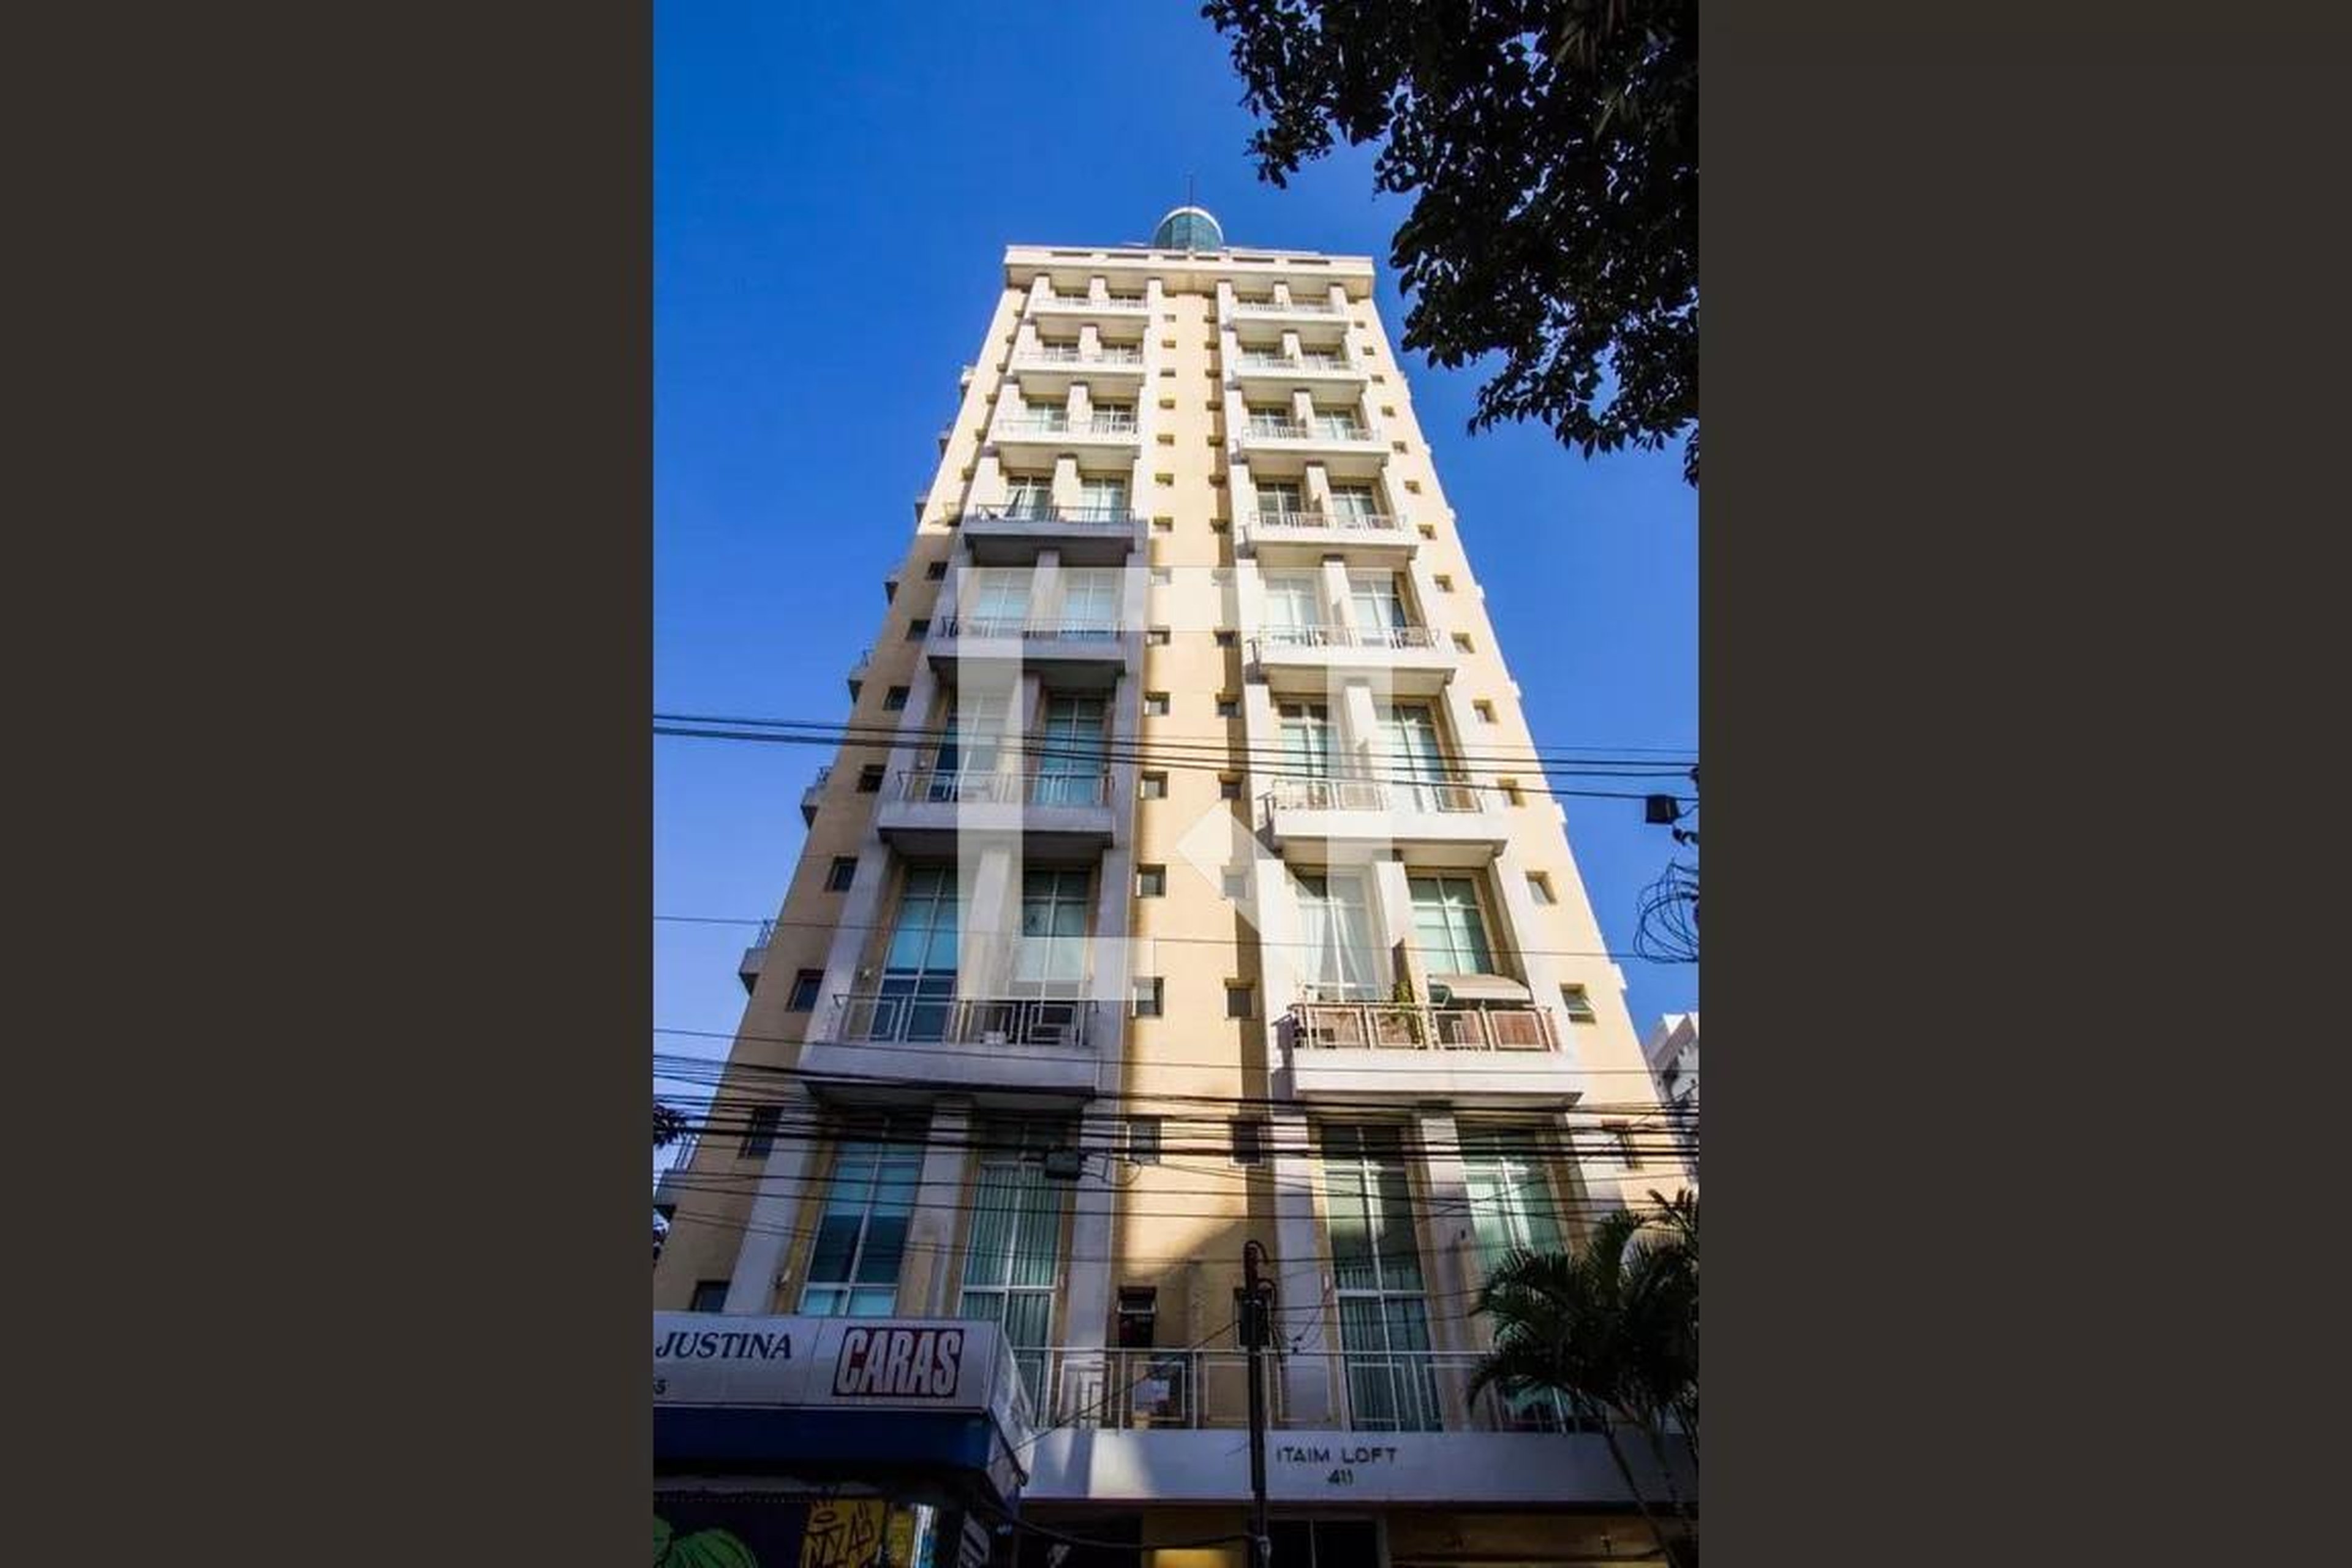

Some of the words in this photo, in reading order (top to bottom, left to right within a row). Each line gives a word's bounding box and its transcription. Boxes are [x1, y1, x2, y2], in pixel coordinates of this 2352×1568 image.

[655, 1332, 791, 1359] JUSTINA
[837, 1329, 962, 1395] CARAS
[1277, 1446, 1330, 1463] ITAIM
[1341, 1447, 1397, 1463] LOFT
[1327, 1469, 1354, 1485] 411
